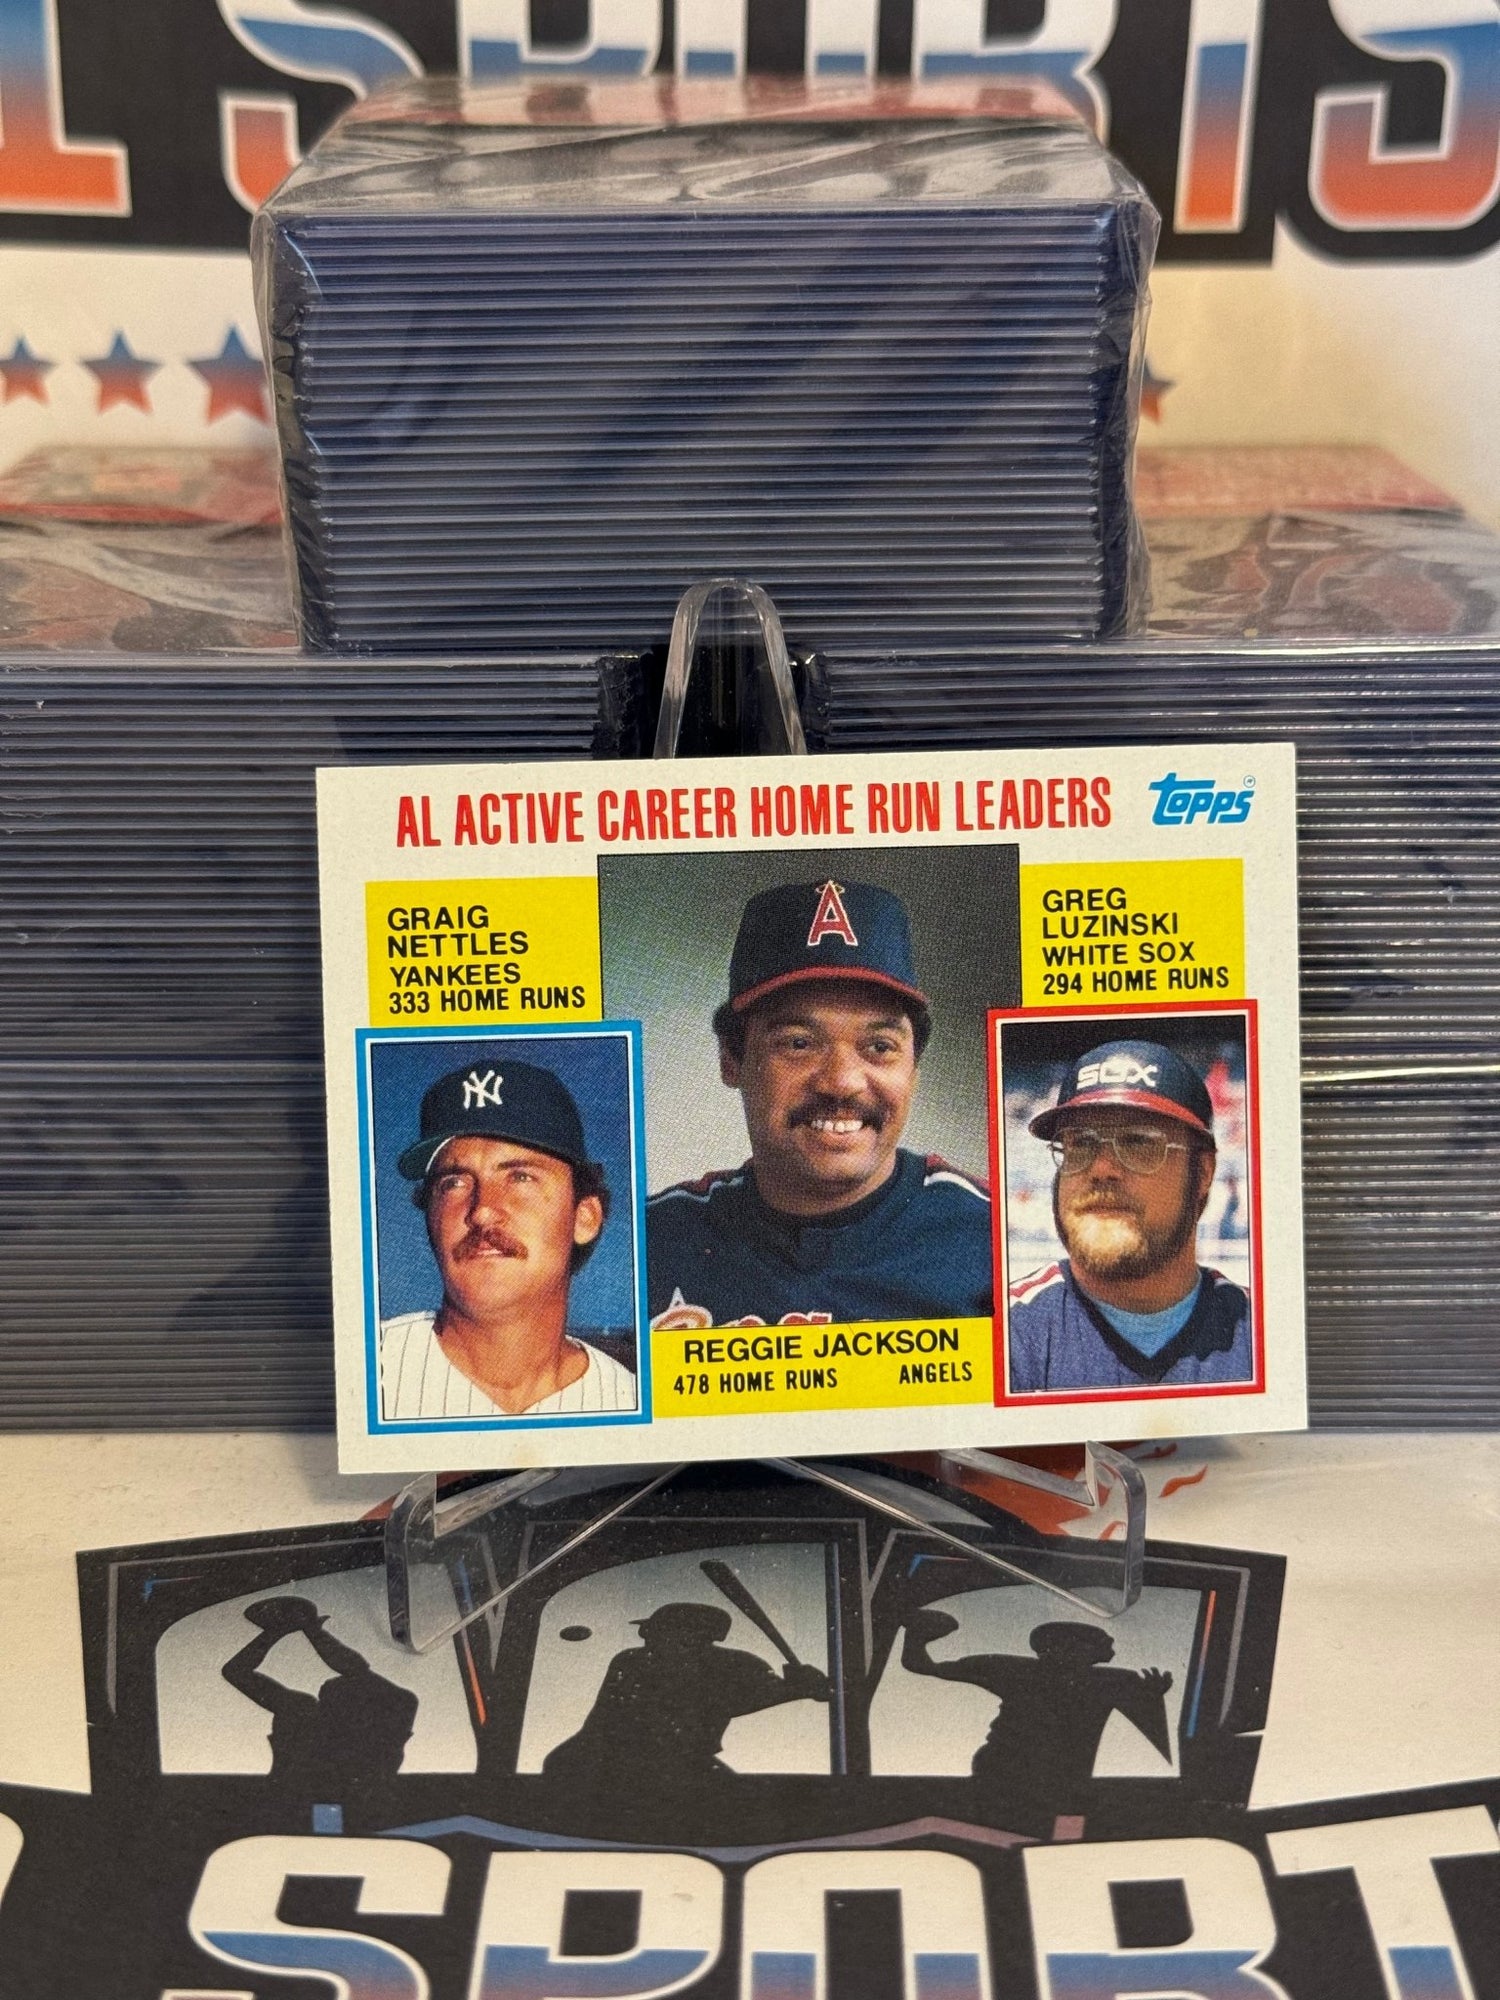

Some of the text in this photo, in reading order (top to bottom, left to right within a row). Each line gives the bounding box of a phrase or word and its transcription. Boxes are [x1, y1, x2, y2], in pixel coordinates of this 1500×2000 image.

[396, 776, 1112, 848] AL ACTIVE CAREER HOME RUN LEADERS
[807, 880, 858, 946] A
[1042, 887, 1127, 913] GREG
[387, 904, 489, 931] GRAIG
[1042, 912, 1178, 939] LUZINSKI
[387, 931, 529, 959] NETTLES
[1042, 941, 1195, 967] WHITE SOX
[389, 962, 521, 988] YANKEES
[1042, 966, 1229, 995] 294 HOME RUNS
[389, 985, 586, 1014] 333 HOME RUNS
[1076, 1055, 1158, 1090] SOX
[463, 1069, 503, 1110] NY
[684, 1327, 959, 1364] REGGIE JACKSON
[673, 1367, 838, 1395] 478 HOME RUNS
[899, 1361, 973, 1385] ANGELS
[160, 1804, 1500, 2000] SPORT
